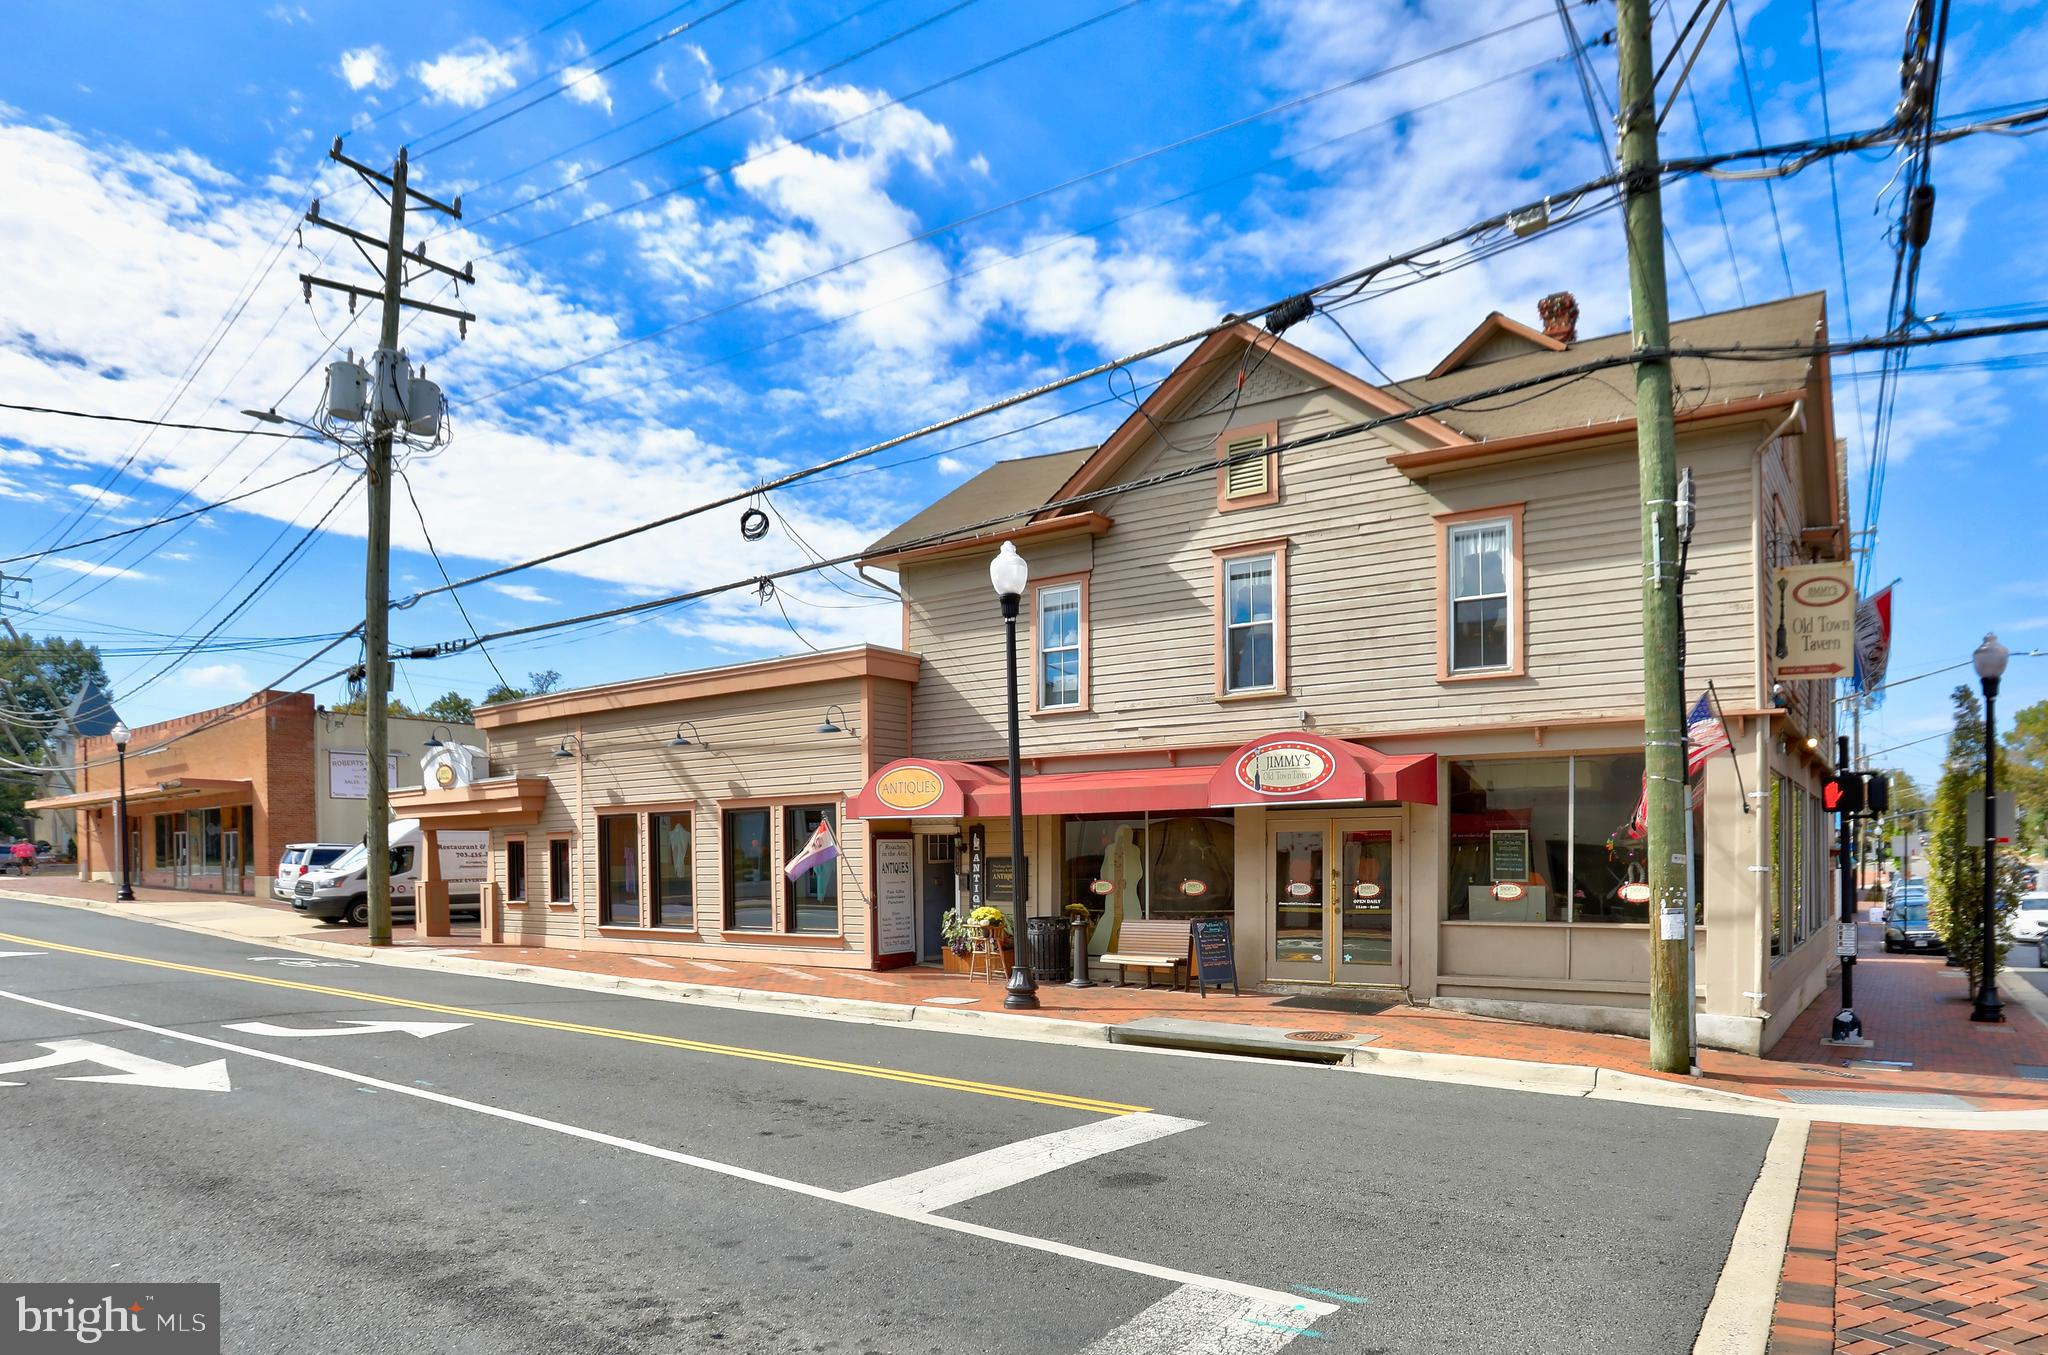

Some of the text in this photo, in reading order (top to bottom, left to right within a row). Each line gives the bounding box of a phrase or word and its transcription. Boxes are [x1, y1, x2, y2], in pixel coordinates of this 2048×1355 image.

[1807, 585, 1838, 595] JIMMY'S
[1792, 615, 1850, 634] Old Town
[1801, 635, 1841, 652] Tavern
[1266, 754, 1311, 770] JIMMY'S
[1263, 770, 1312, 781] Old Town Tavern
[882, 780, 937, 795] ANTIQUES
[882, 862, 909, 875] ANTIQUES
